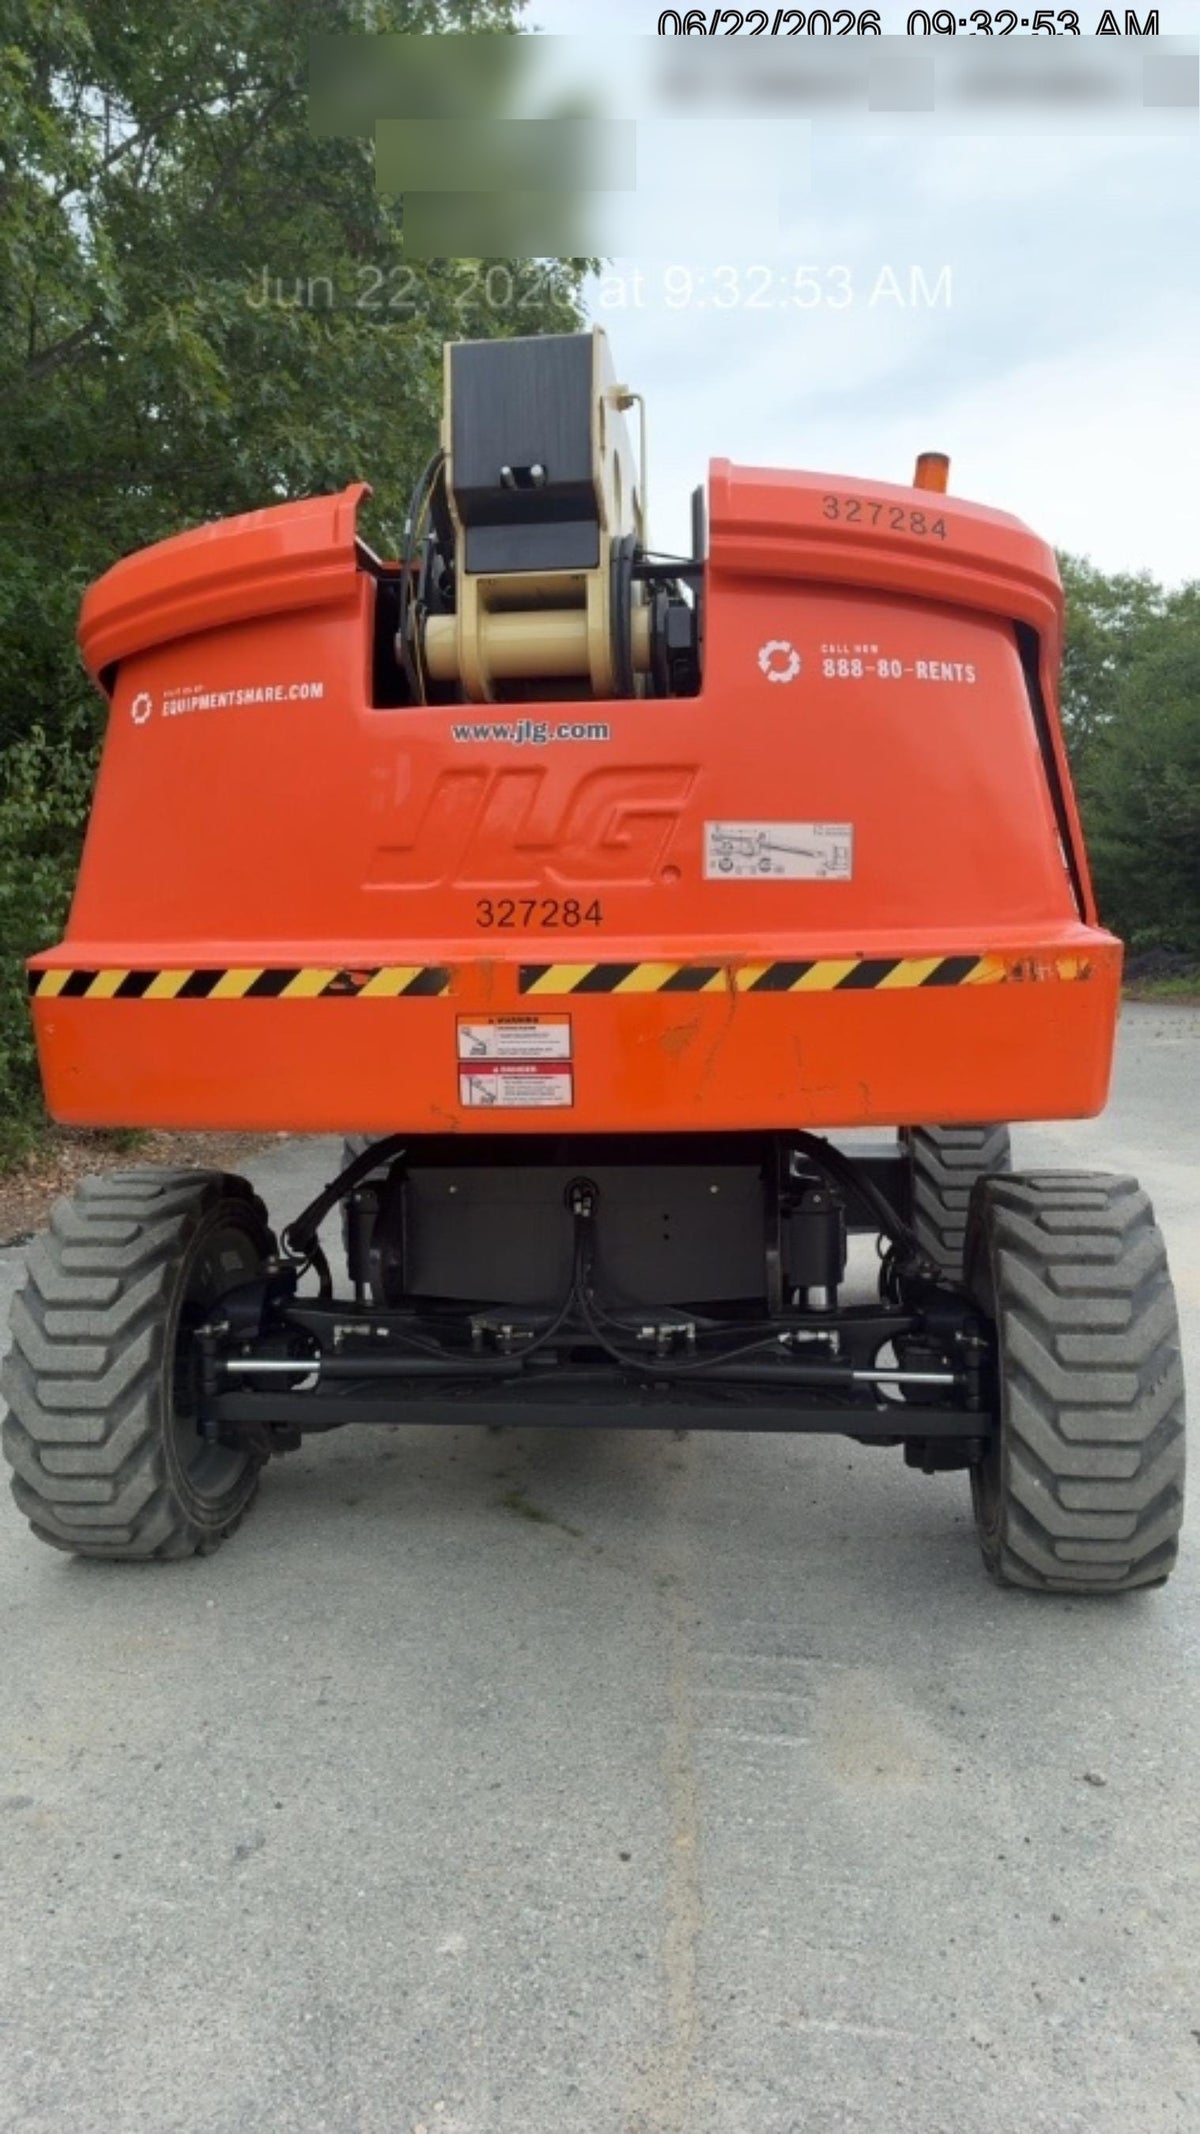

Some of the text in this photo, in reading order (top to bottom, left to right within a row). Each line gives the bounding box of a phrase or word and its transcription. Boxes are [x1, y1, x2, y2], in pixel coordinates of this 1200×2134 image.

[822, 495, 948, 541] 327284
[822, 658, 976, 684] 888-80-RENTS
[161, 682, 324, 717] EQUIPMENTSHARE.COM
[452, 721, 611, 743] www.jlg.com
[476, 900, 603, 928] 327284
